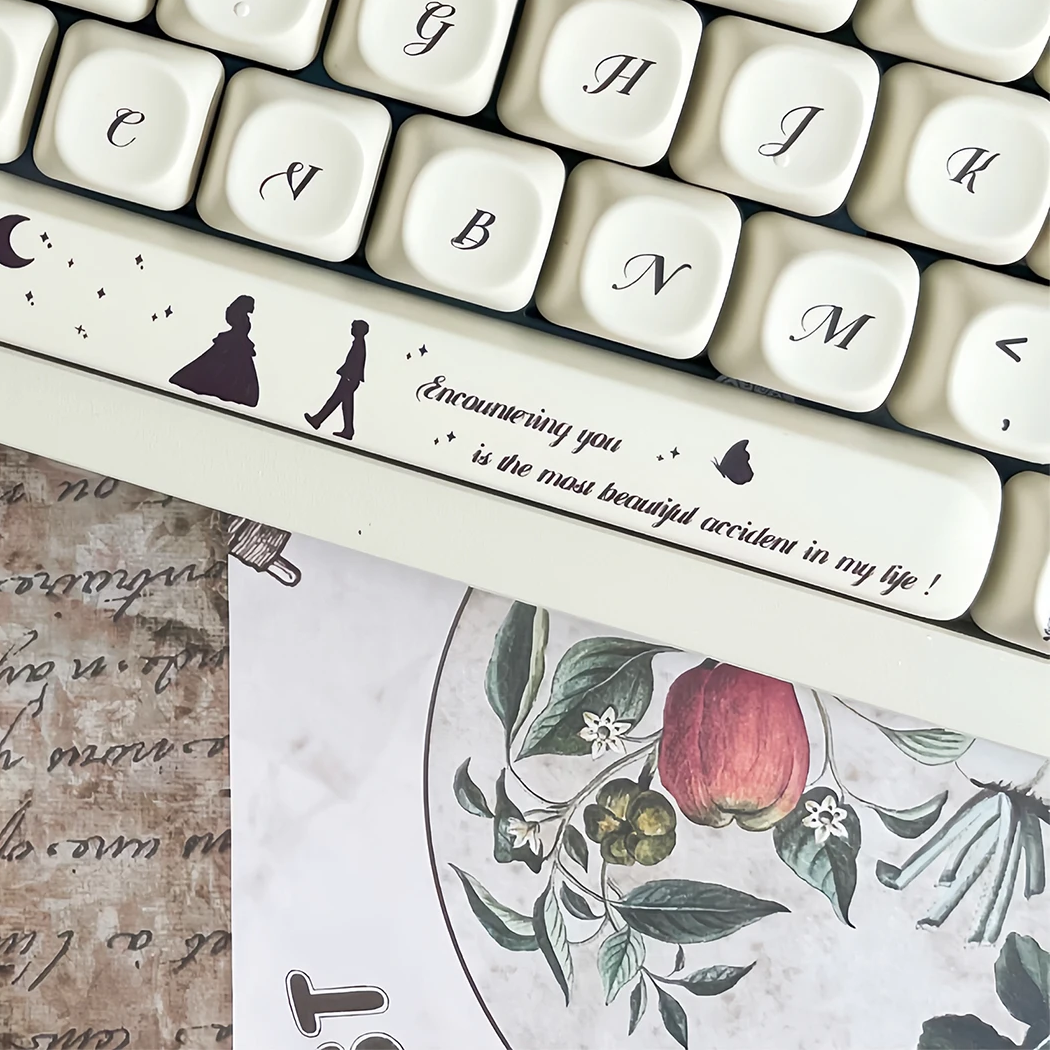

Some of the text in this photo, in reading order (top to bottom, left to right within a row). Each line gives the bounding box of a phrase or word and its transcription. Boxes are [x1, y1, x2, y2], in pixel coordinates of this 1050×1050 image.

[404, 2, 455, 56] G
[107, 108, 145, 147] C
[947, 148, 1000, 193] K
[451, 209, 495, 250] B
[612, 254, 691, 295] N
[790, 305, 875, 350] M
[416, 375, 623, 454] Encountering you
[472, 443, 492, 466] is
[497, 453, 533, 478] the
[536, 468, 596, 496] most
[700, 512, 798, 555] accident
[802, 540, 829, 565] in
[834, 555, 876, 587] my
[879, 564, 918, 596] life
